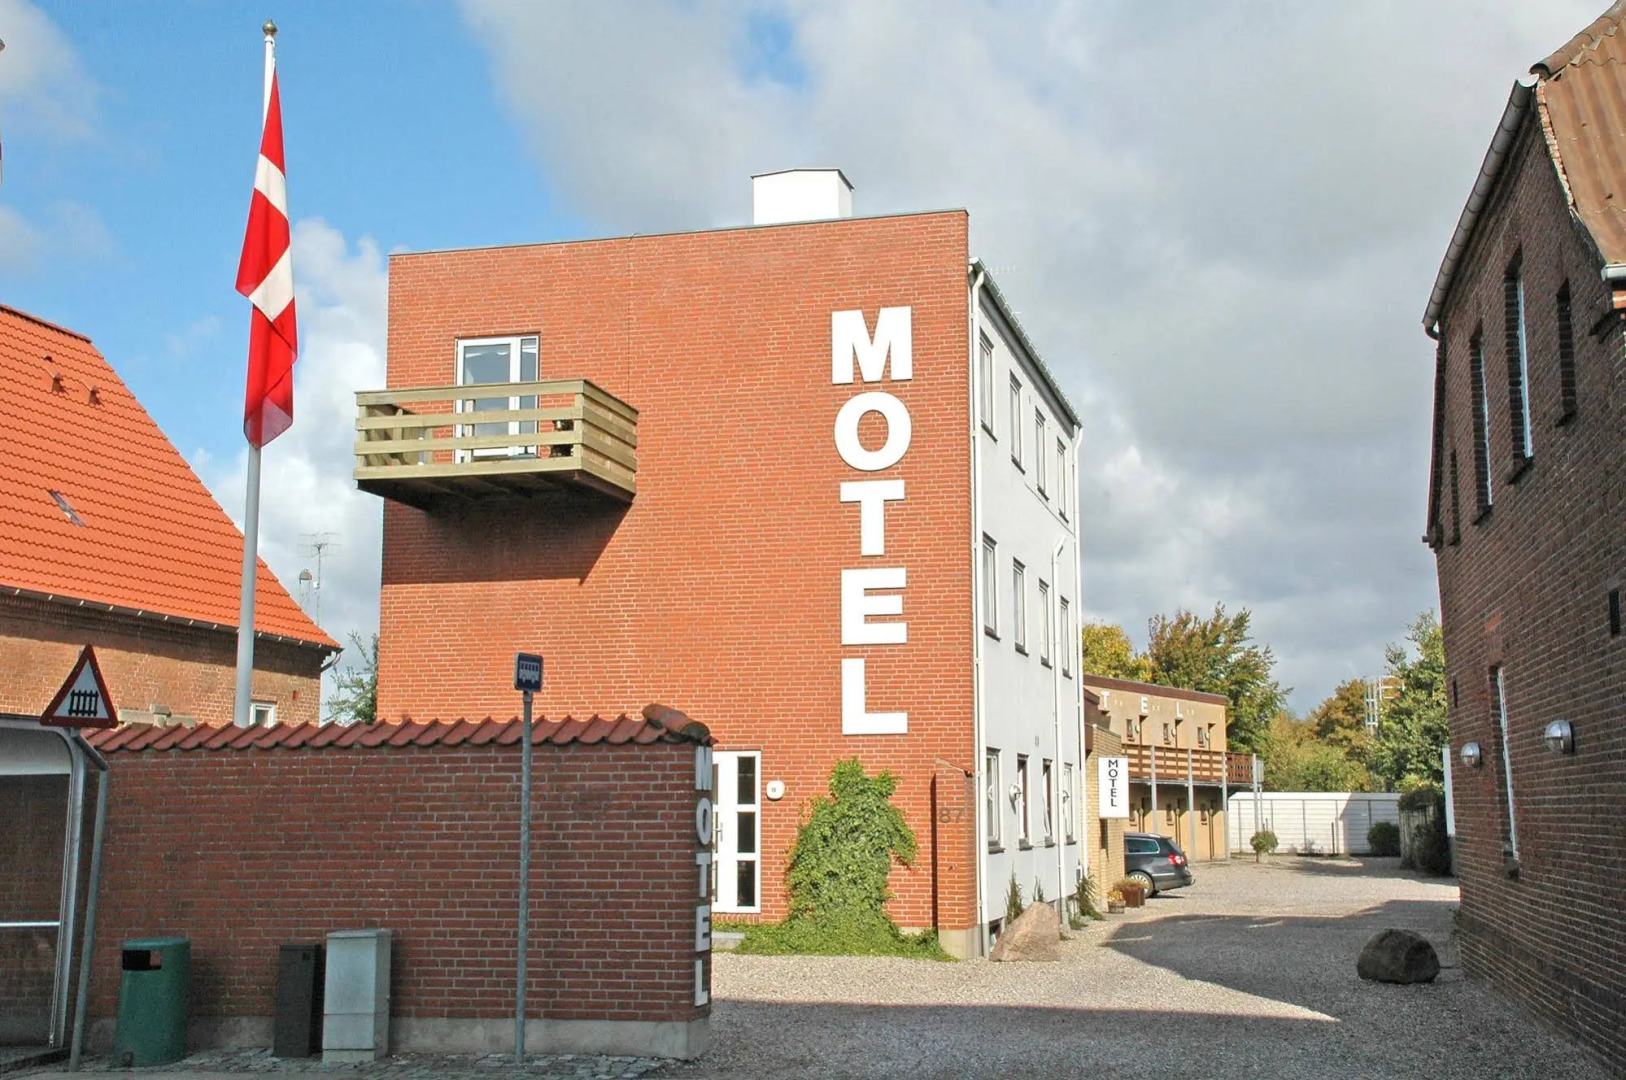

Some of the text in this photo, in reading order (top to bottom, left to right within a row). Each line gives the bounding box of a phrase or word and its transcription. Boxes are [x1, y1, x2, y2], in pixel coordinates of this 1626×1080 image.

[831, 306, 913, 736] MOTEL
[939, 807, 966, 824] 87
[1108, 759, 1118, 807] MOTEL
[694, 746, 713, 1008] MOTEL
